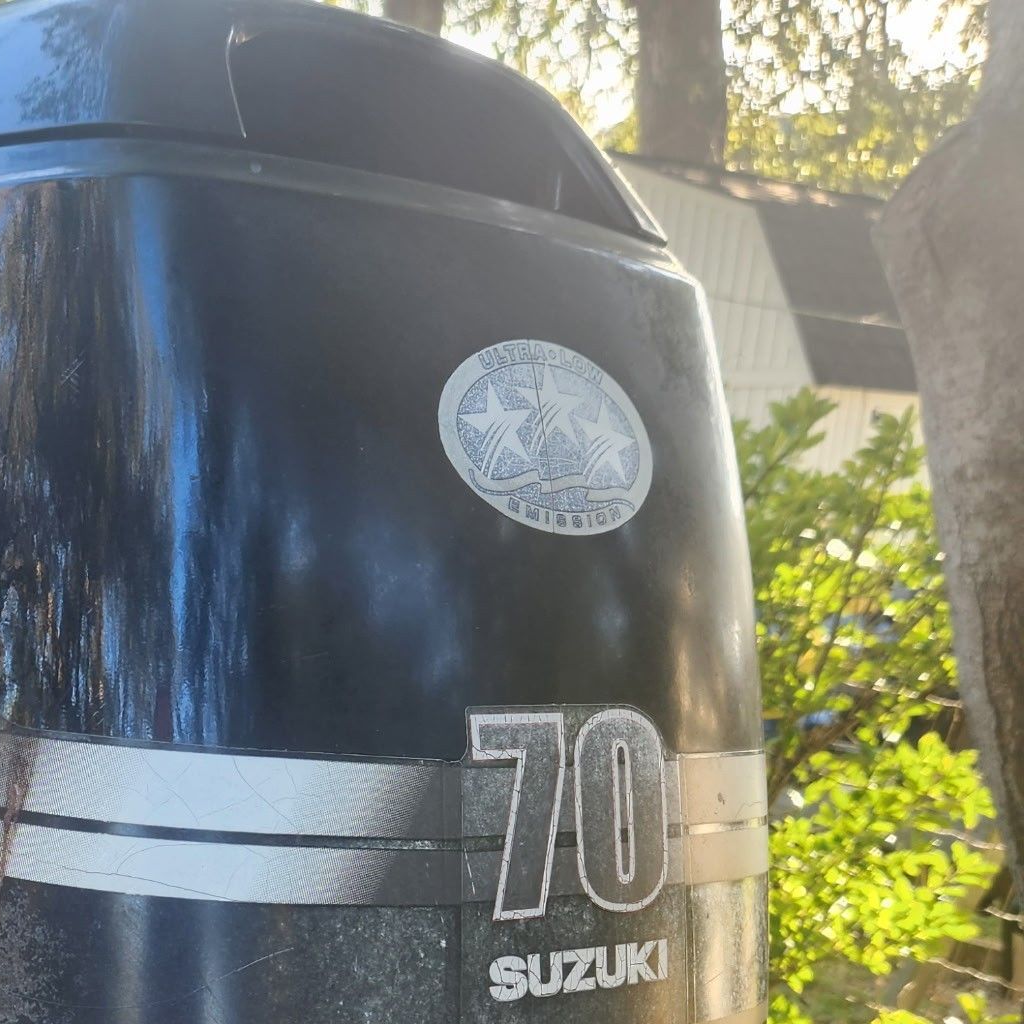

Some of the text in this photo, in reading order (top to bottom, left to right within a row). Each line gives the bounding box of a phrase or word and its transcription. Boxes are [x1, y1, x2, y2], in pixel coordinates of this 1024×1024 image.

[478, 342, 604, 385] ULTRA LOW
[508, 497, 621, 528] EMISSION
[470, 709, 668, 920] 70
[489, 938, 668, 1001] SUZUKI
